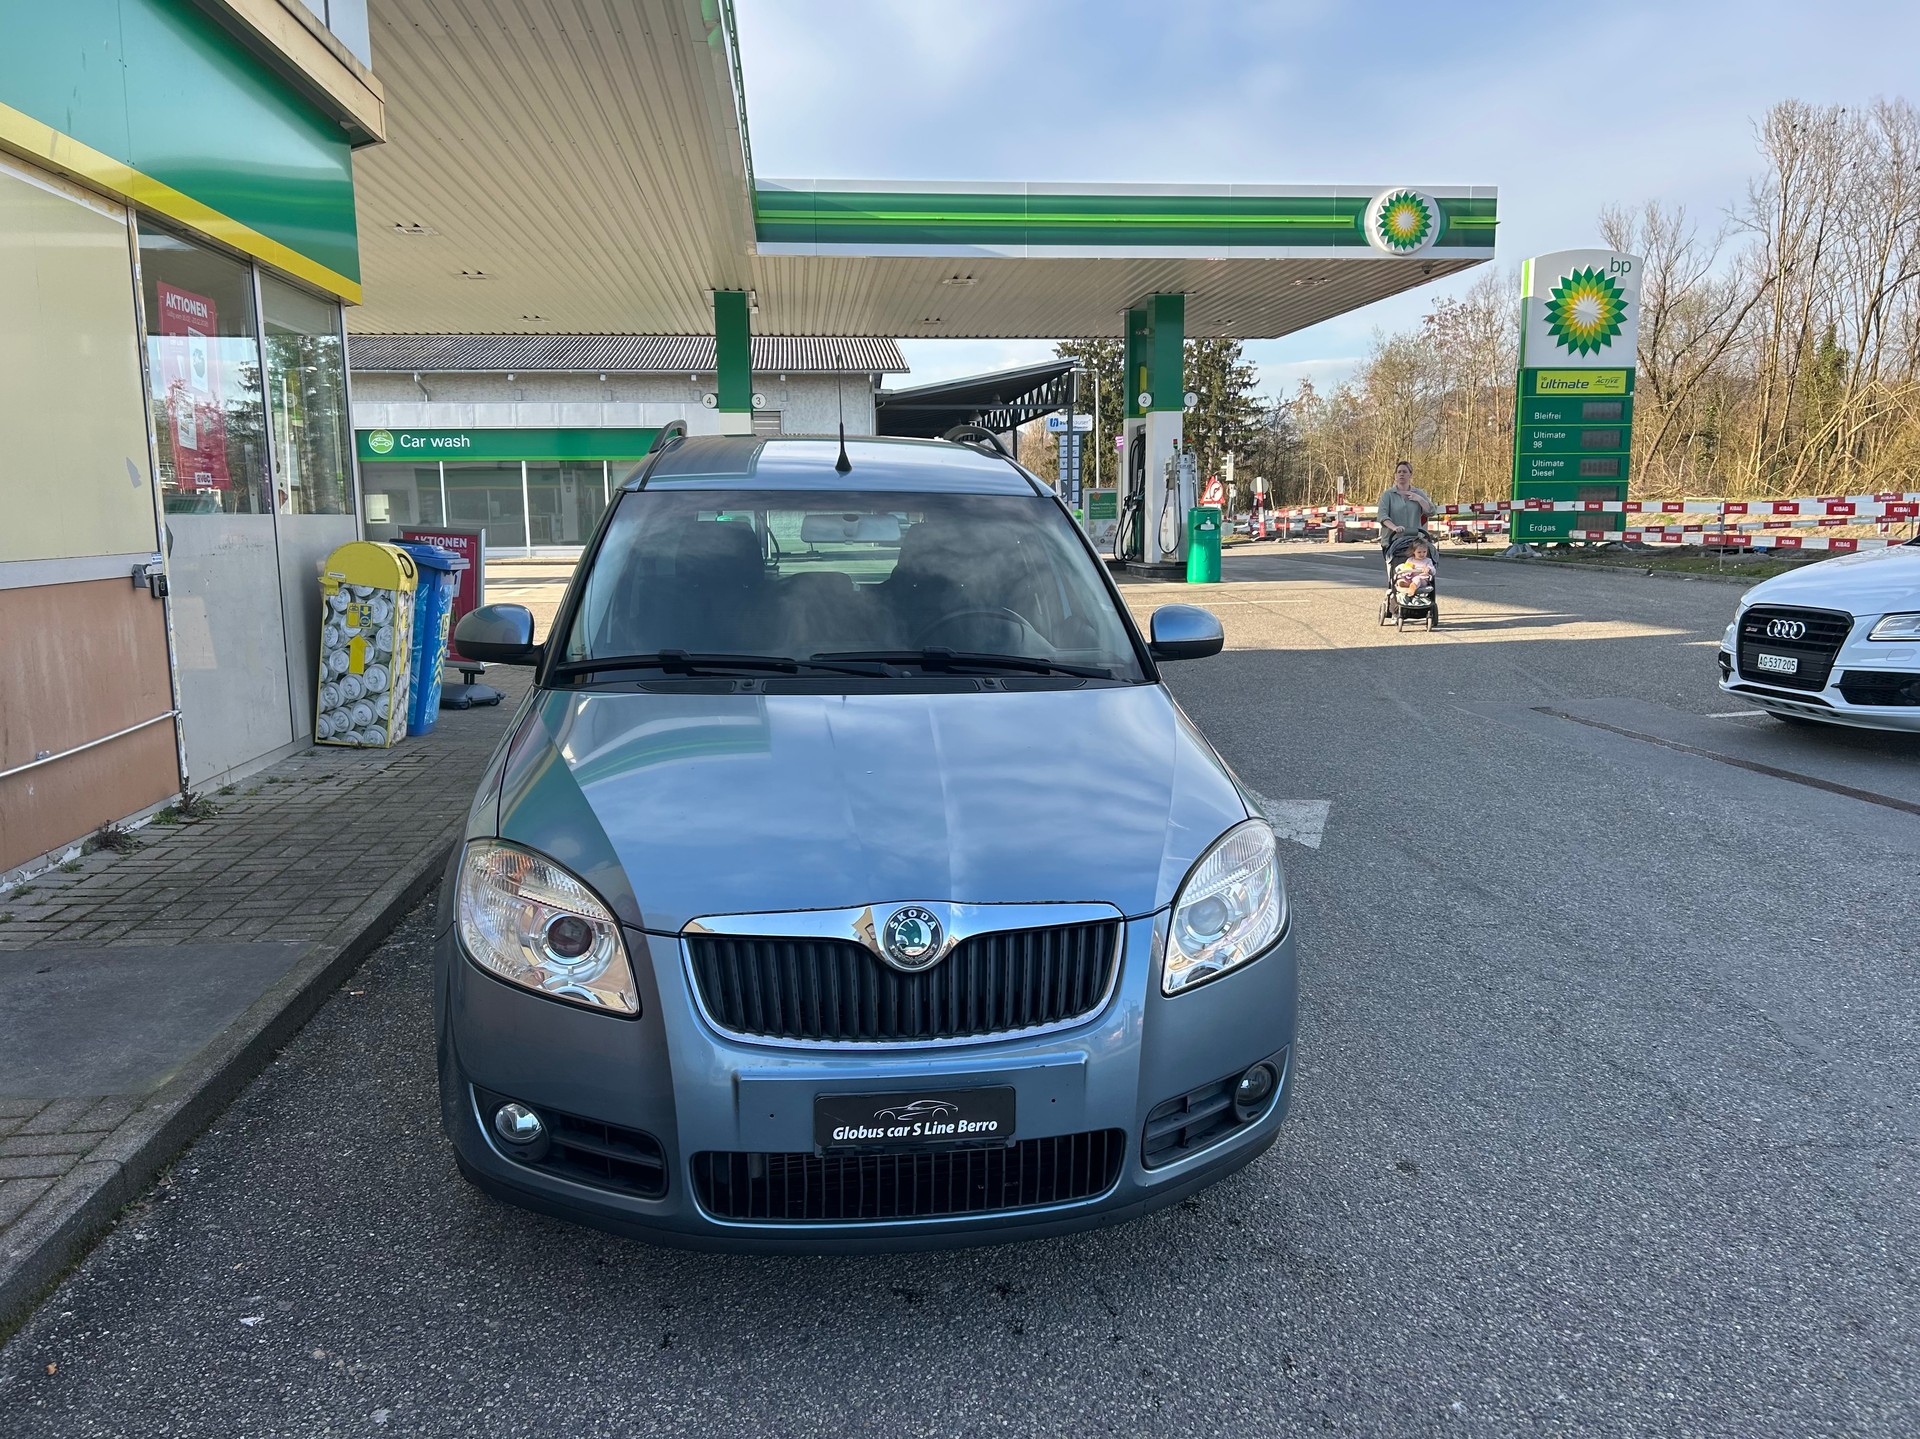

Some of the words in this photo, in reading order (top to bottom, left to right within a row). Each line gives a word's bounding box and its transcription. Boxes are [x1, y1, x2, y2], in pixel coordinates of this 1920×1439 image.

[1610, 257, 1631, 276] bp
[166, 292, 207, 318] AKTIONEN
[1541, 379, 1589, 389] ultimate
[400, 434, 426, 448] Car
[430, 434, 470, 448] wash
[1533, 431, 1566, 439] Ultimate
[1529, 524, 1556, 533] Erdgas
[832, 1125, 884, 1141] Globus
[886, 1125, 911, 1137] car
[912, 1122, 922, 1136] S
[924, 1120, 955, 1135] Line
[957, 1119, 998, 1133] Berro
